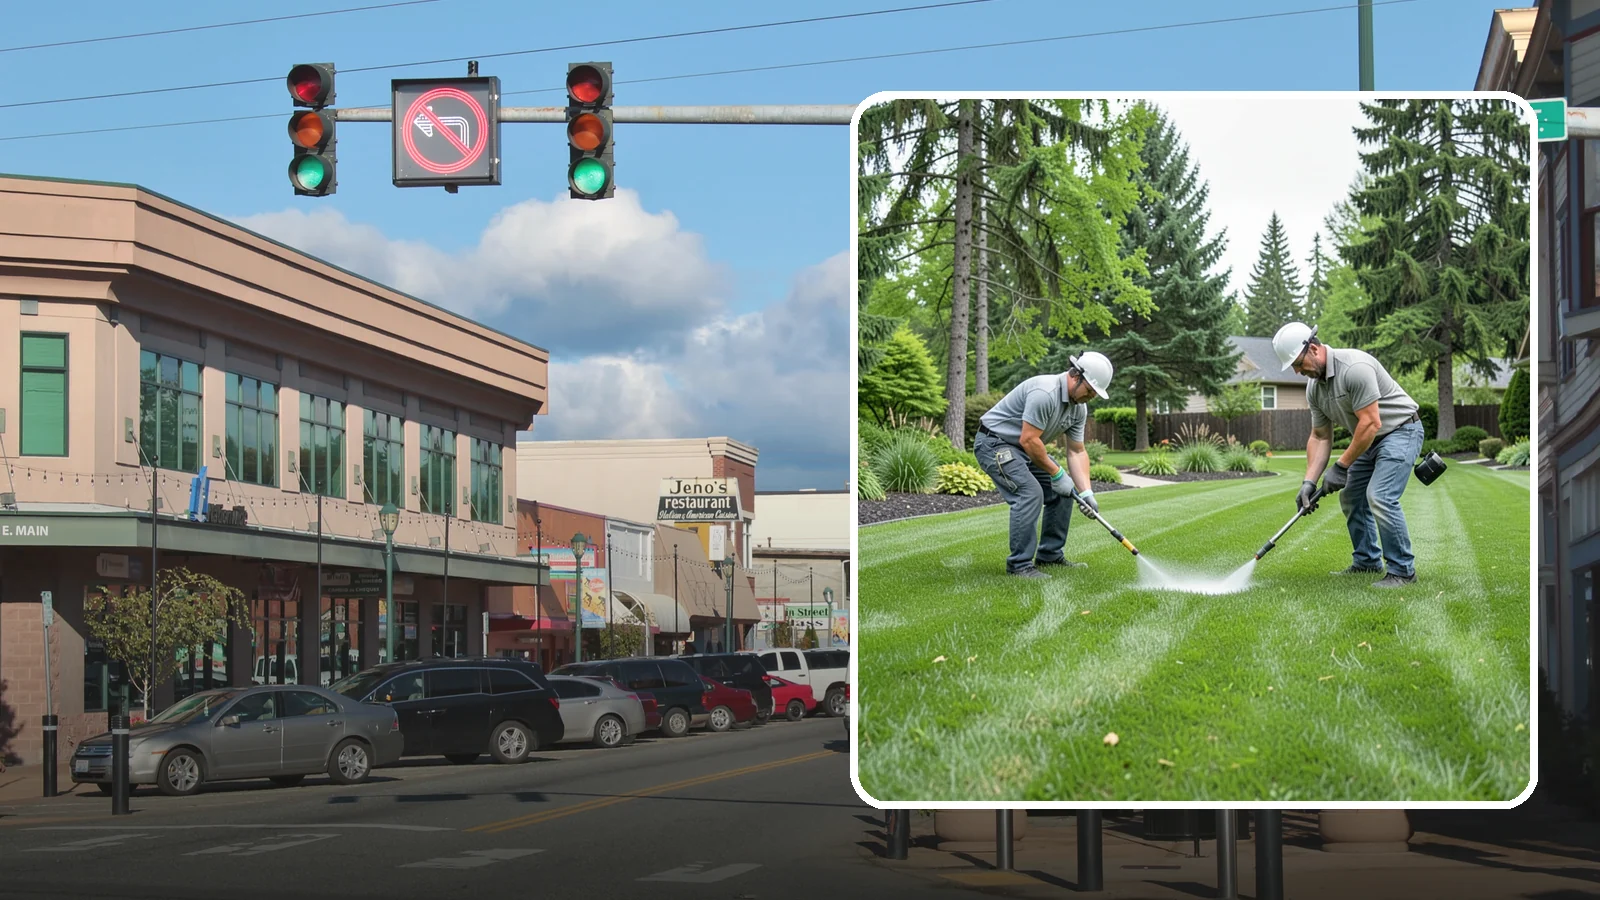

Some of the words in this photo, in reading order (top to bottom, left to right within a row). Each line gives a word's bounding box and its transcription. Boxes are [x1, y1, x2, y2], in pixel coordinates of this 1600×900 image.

[670, 480, 727, 494] Jeno's
[665, 497, 731, 508] restaurant
[658, 510, 681, 519] Italian
[686, 510, 714, 518] American
[715, 510, 737, 518] Cuisine
[2, 525, 13, 536] E.
[15, 525, 49, 536] MAIN
